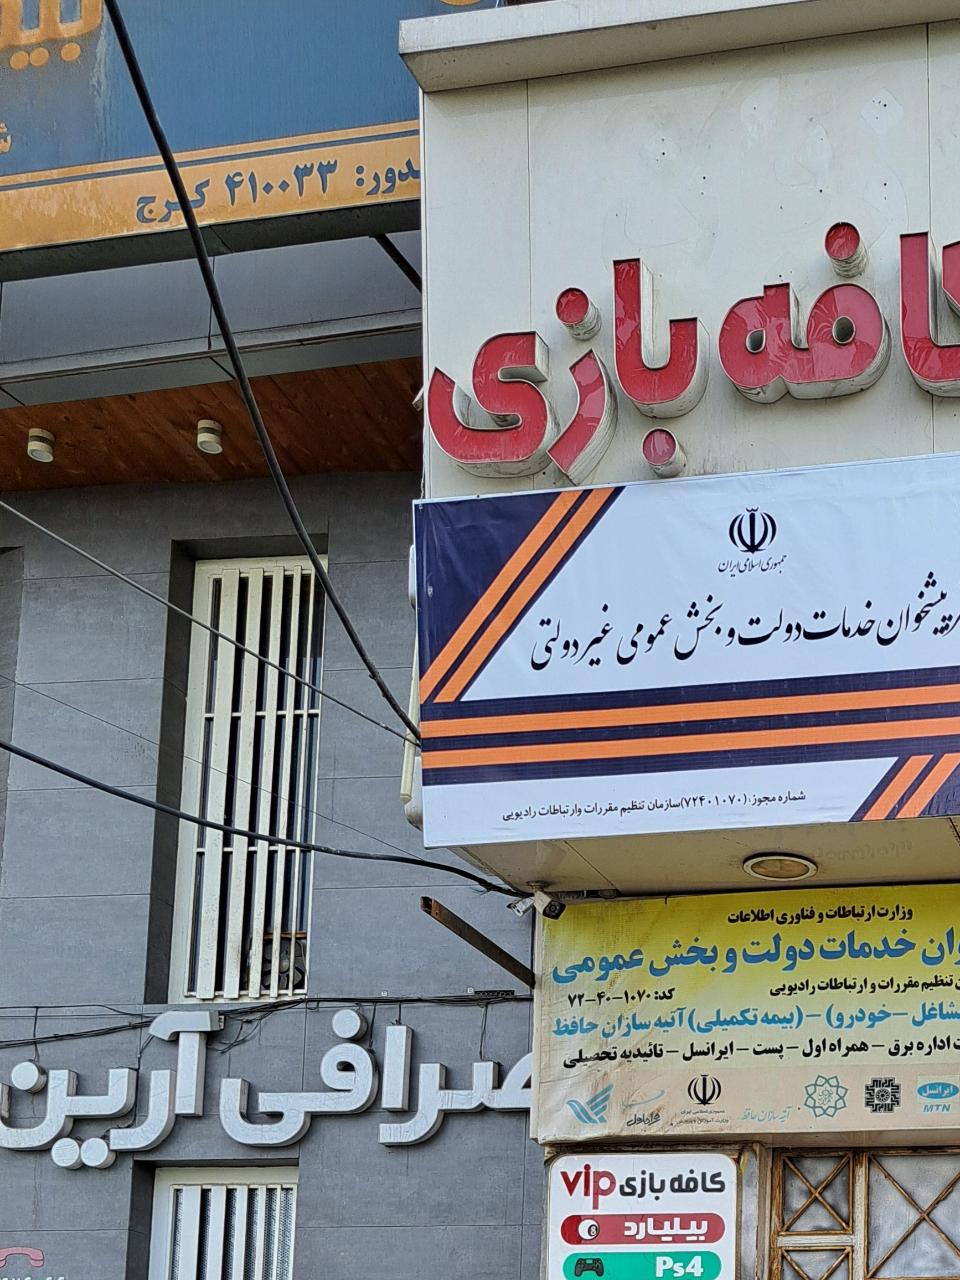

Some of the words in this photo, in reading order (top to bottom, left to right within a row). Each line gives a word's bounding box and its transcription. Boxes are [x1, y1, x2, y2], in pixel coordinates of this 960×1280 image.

[225, 160, 337, 206] ۴۱۰۰۳۳
[356, 158, 420, 195] دور:
[136, 178, 210, 223] کرج
[428, 258, 707, 482] بازی
[876, 571, 951, 646] پیشخوان
[674, 594, 724, 661] بخش
[738, 607, 801, 646] دولت
[802, 600, 876, 641] خدمات
[616, 613, 673, 665] عمومی
[778, 790, 807, 805] شماره
[502, 805, 537, 821] رادیویی
[583, 802, 619, 816] مقررات
[620, 800, 645, 817] تنظیم
[727, 908, 775, 924] اطلاعات
[775, 906, 816, 925] فناوری
[817, 913, 824, 923] و
[825, 905, 876, 922] ارتباطات
[877, 904, 914, 920] وزارت
[742, 932, 815, 972] دولت
[819, 928, 916, 960] خدمات
[552, 948, 644, 984] عمومی
[648, 936, 718, 977] بخش
[721, 947, 738, 973] و
[769, 979, 815, 996] رادیویی
[817, 977, 868, 994] ارتباطات
[869, 983, 876, 993] و
[877, 976, 920, 993] مقررات
[921, 974, 953, 991] تنظیم
[654, 987, 676, 1001] کد:
[552, 1016, 598, 1037] حافظ
[602, 1012, 650, 1038] سازان
[654, 1006, 687, 1032] آتیه
[682, 1040, 734, 1060] ایرانسل
[752, 1042, 784, 1060] پست
[802, 1038, 826, 1058] اول
[829, 1038, 869, 1057] همراه
[888, 1039, 914, 1057] برق
[916, 1035, 951, 1056] اداره
[563, 1046, 617, 1068] تحصیلی
[0, 1010, 225, 1170] آرین
[921, 1085, 954, 1098] ایرانسل
[923, 1104, 951, 1113] MTN
[560, 1164, 617, 1210] vip
[619, 1169, 666, 1201] بازی
[670, 1168, 726, 1194] کافه
[623, 1218, 708, 1241] بیلیارد
[655, 1256, 704, 1278] Ps4
